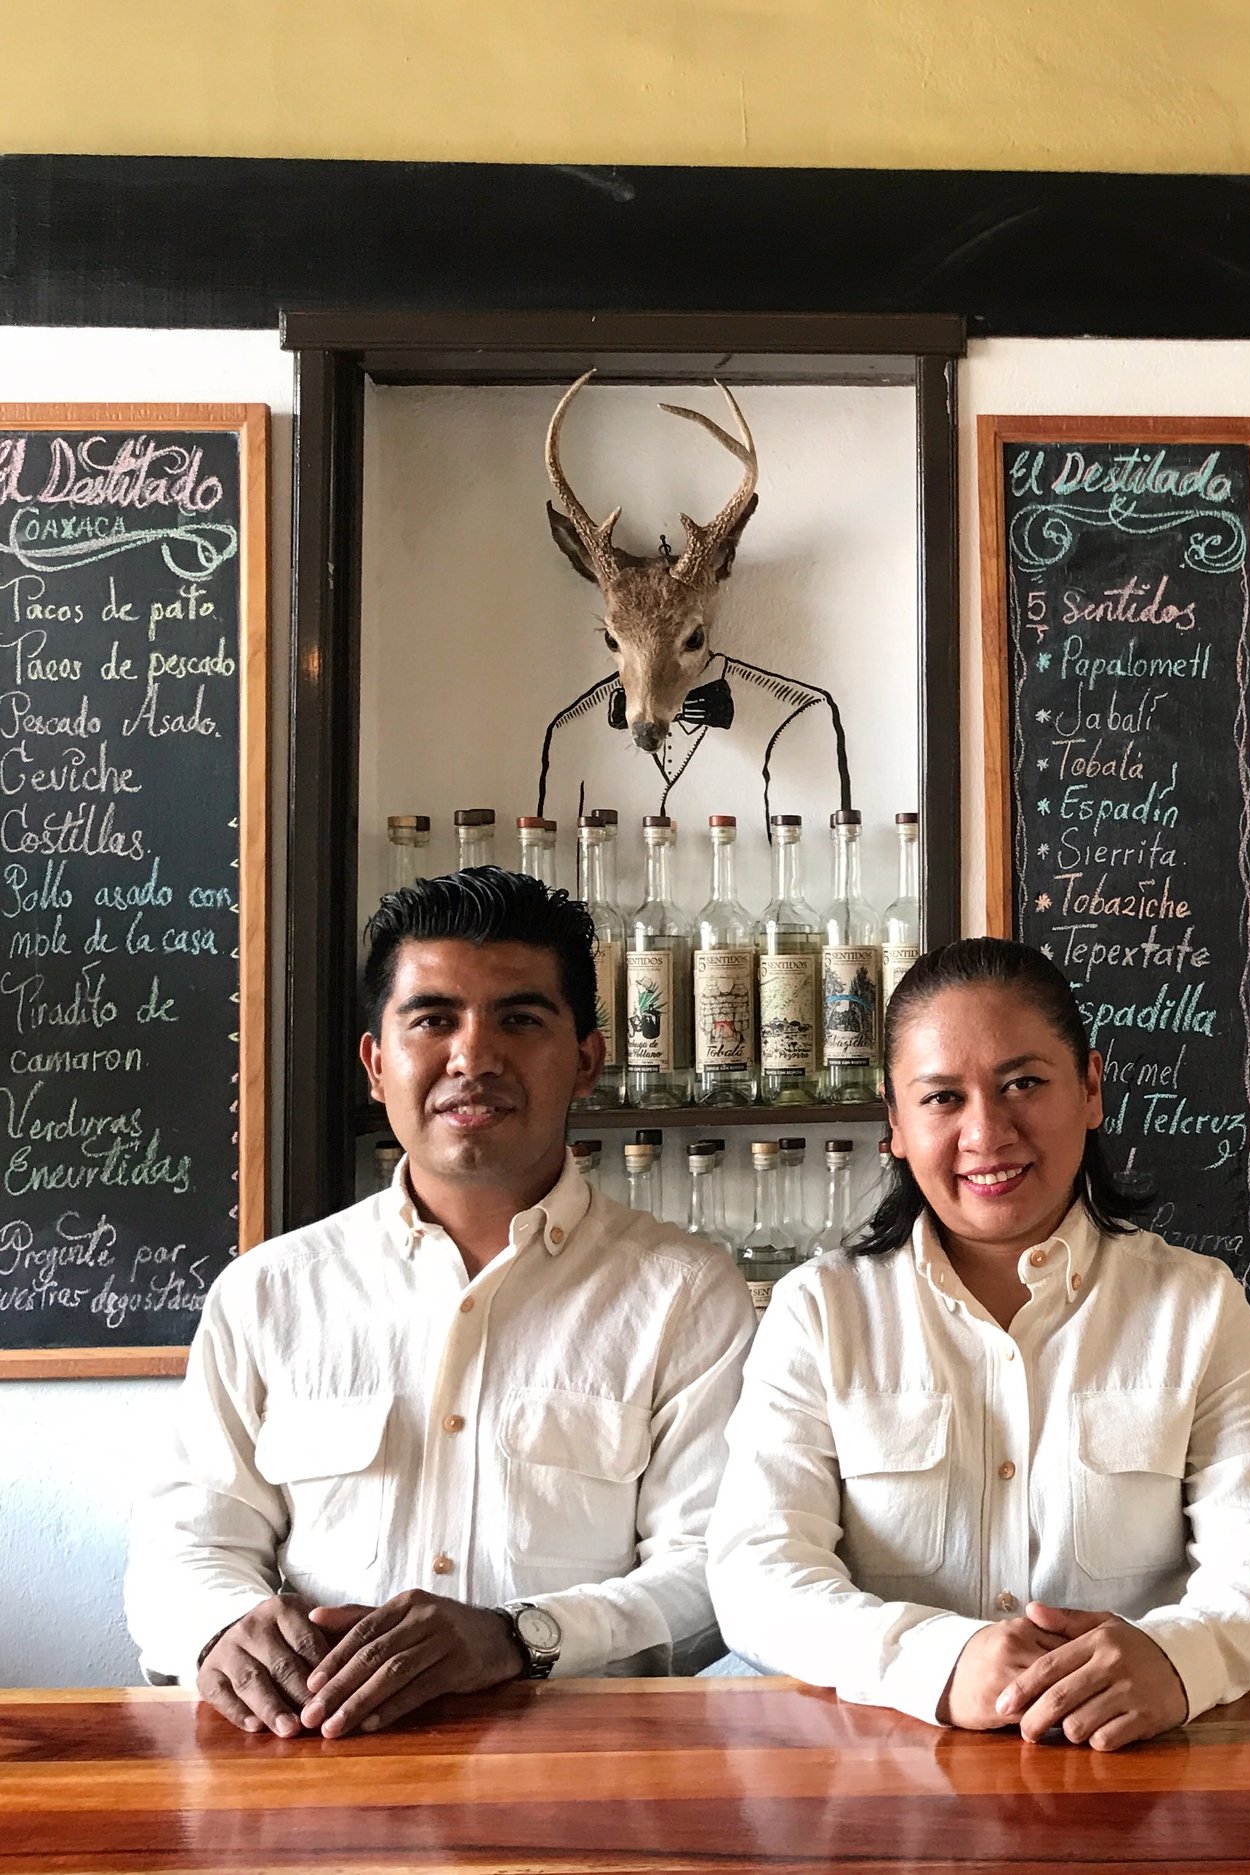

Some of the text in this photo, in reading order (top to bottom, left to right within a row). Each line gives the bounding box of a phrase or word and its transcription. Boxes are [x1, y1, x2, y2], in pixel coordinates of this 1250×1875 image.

[38, 436, 223, 513] Destilado
[1009, 447, 1235, 502] El Destilado
[102, 576, 140, 622] de
[1026, 574, 1196, 632] 5 Sentidos
[101, 641, 138, 680] de
[149, 637, 235, 690] pescado
[0, 691, 101, 739] Pescado
[0, 740, 141, 795] Ceviche
[1052, 738, 1145, 782] Tobalá
[3, 856, 233, 918] Pollo asado con
[10, 915, 71, 958] mole
[84, 918, 117, 954] de
[127, 911, 156, 955] la
[832, 950, 873, 960] SENTIDOS
[890, 949, 919, 957] SENTID
[1052, 923, 1212, 983] Tepextate
[628, 956, 663, 966] ENTIDOS
[707, 956, 747, 965] SENTIDOS
[767, 961, 808, 970] SENTIDOS
[137, 975, 180, 1023] de
[0, 1081, 143, 1139] Verduras
[130, 1243, 186, 1283] por
[0, 1278, 91, 1311] uestras
